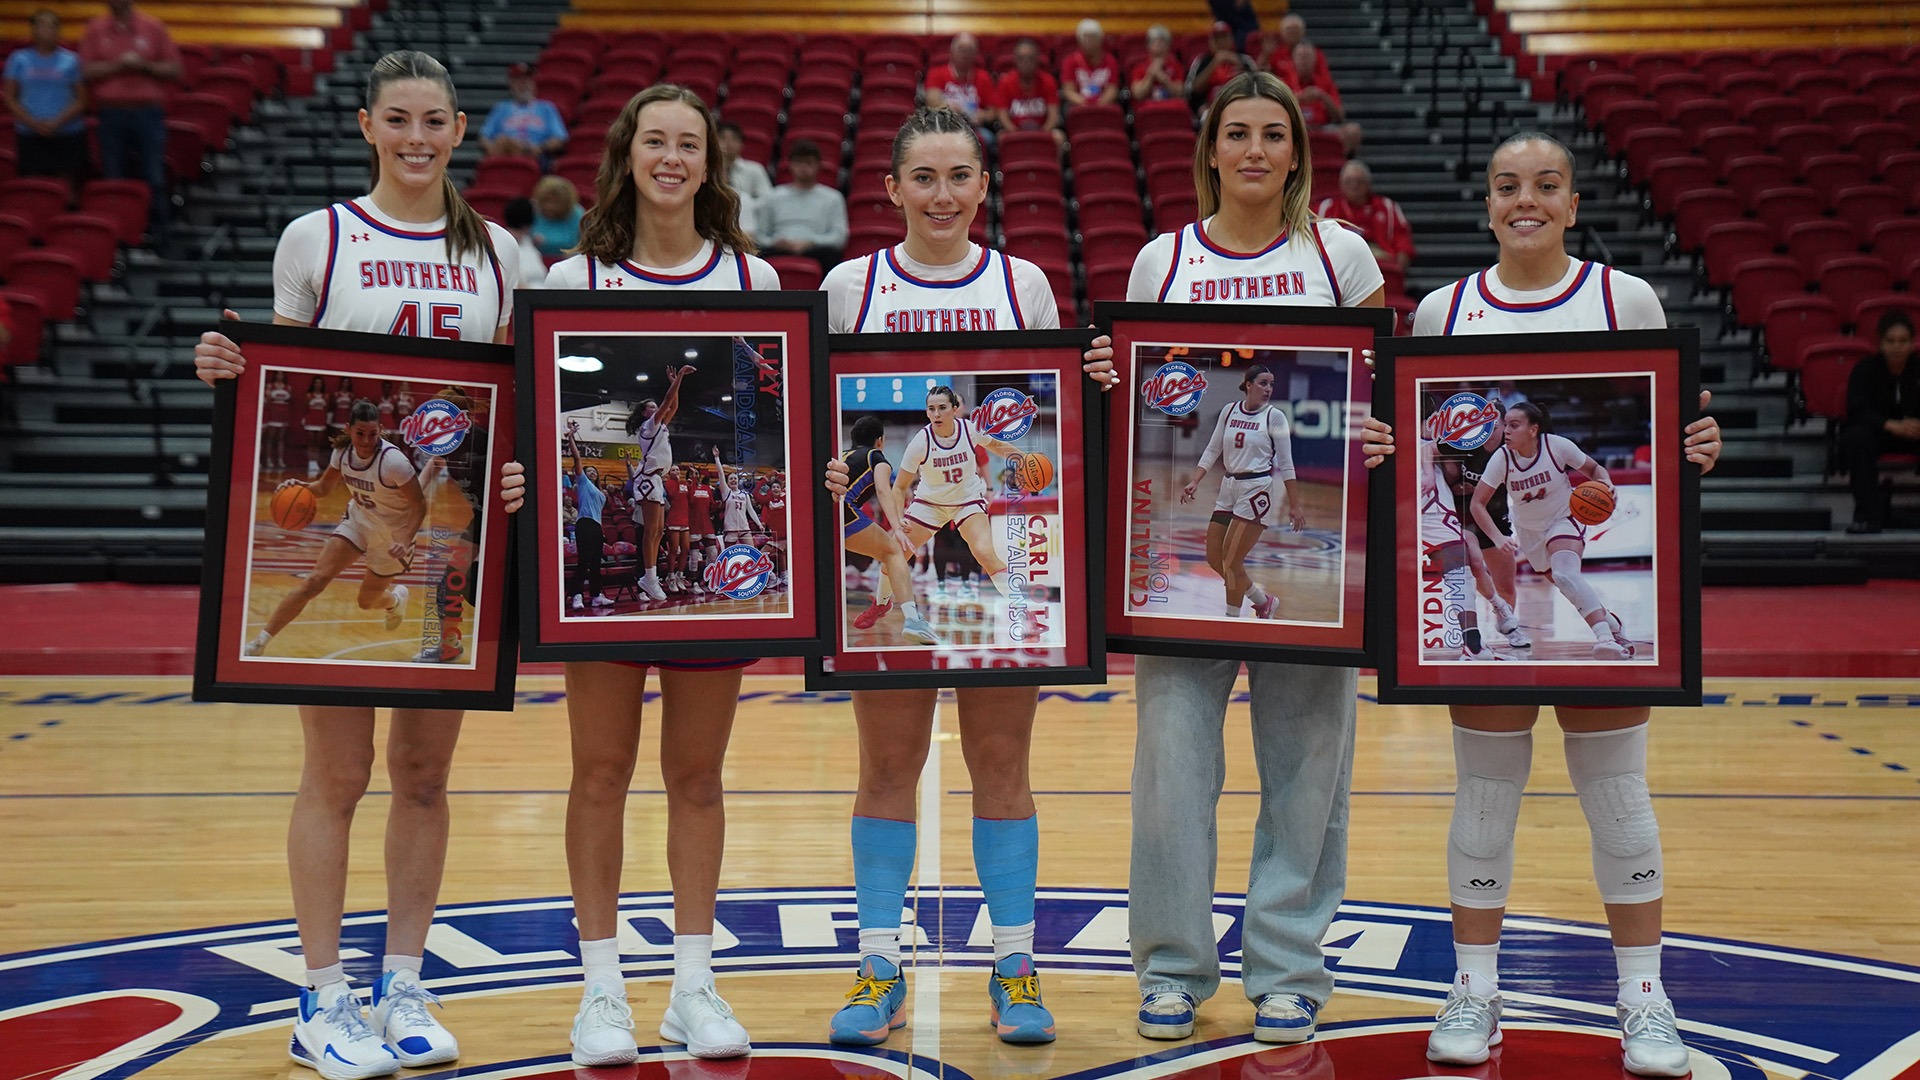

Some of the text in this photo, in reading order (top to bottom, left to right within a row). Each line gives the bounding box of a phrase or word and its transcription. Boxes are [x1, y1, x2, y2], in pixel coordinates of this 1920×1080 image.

[360, 260, 479, 296] SOUTHERN
[1189, 271, 1306, 303] SOUTHERN
[388, 301, 462, 340] 45
[884, 308, 997, 333] SOUTHERN
[758, 343, 780, 397] LILY
[427, 402, 449, 410] FLORIDA
[1141, 372, 1209, 407] Mocs
[1172, 399, 1197, 413] SOUTHERN
[1453, 396, 1476, 404] FLORIDA
[400, 410, 471, 445] Mocs
[970, 398, 1038, 433] Mocs
[1003, 425, 1027, 439] SOUTHERN
[1426, 403, 1501, 442] Mocs
[432, 438, 459, 453] SOUTHERN
[1234, 432, 1246, 449] 9
[1461, 430, 1488, 447] SOUTHERN
[933, 452, 969, 468] SOUTHERN
[942, 468, 964, 484] 12
[1510, 470, 1552, 492] SOUTHERN
[728, 547, 750, 555] FLORIDA
[1129, 479, 1152, 607] CATALINA
[704, 555, 775, 592] Mocs
[737, 582, 763, 598] SOUTHERN
[1028, 515, 1050, 634] CARLOTA
[1149, 552, 1169, 603] ION
[439, 545, 468, 661] MONICA
[1008, 545, 1029, 642] ALONSO
[1422, 540, 1443, 649] SYDNEY
